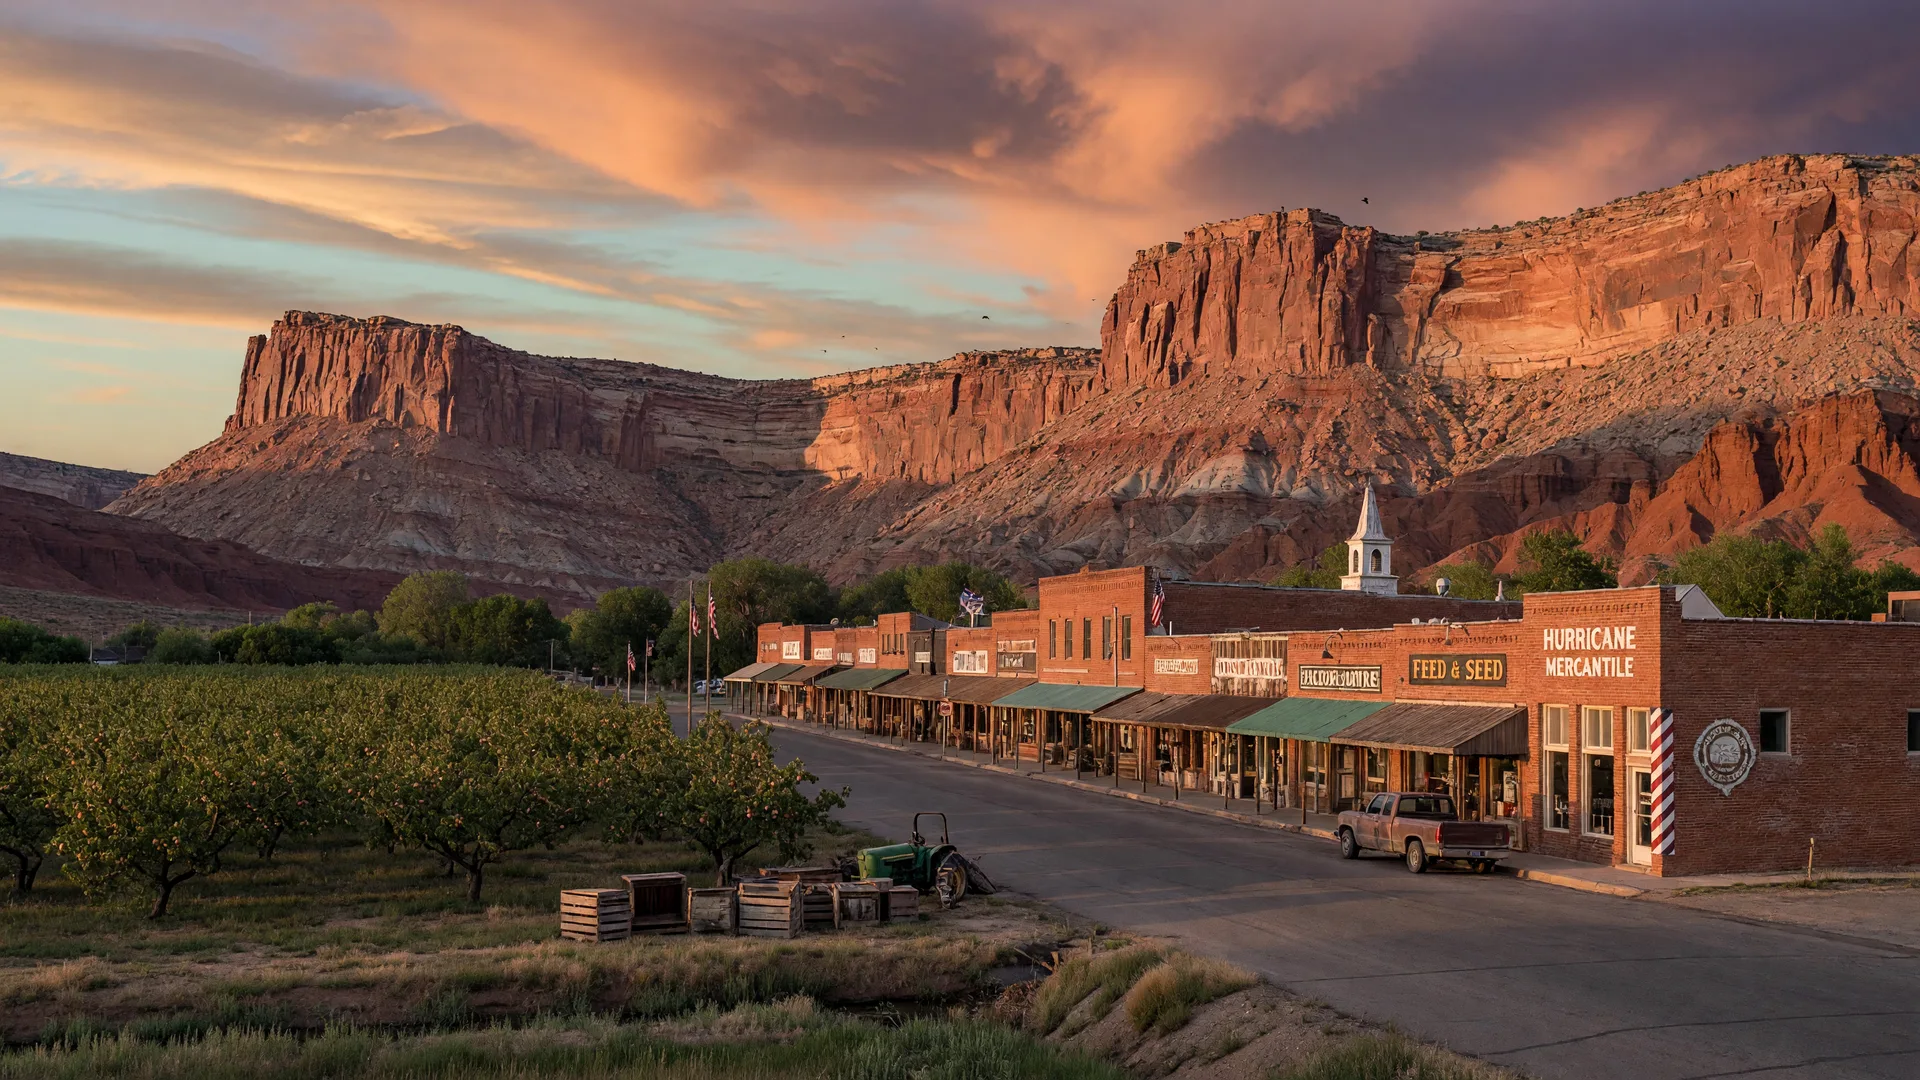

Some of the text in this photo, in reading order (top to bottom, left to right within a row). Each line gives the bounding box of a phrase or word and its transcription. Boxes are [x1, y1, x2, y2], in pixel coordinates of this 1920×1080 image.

[1543, 626, 1637, 651] HURRICANE
[1412, 659, 1503, 680] FEED & SEED
[1545, 656, 1634, 678] MERCANTILE
